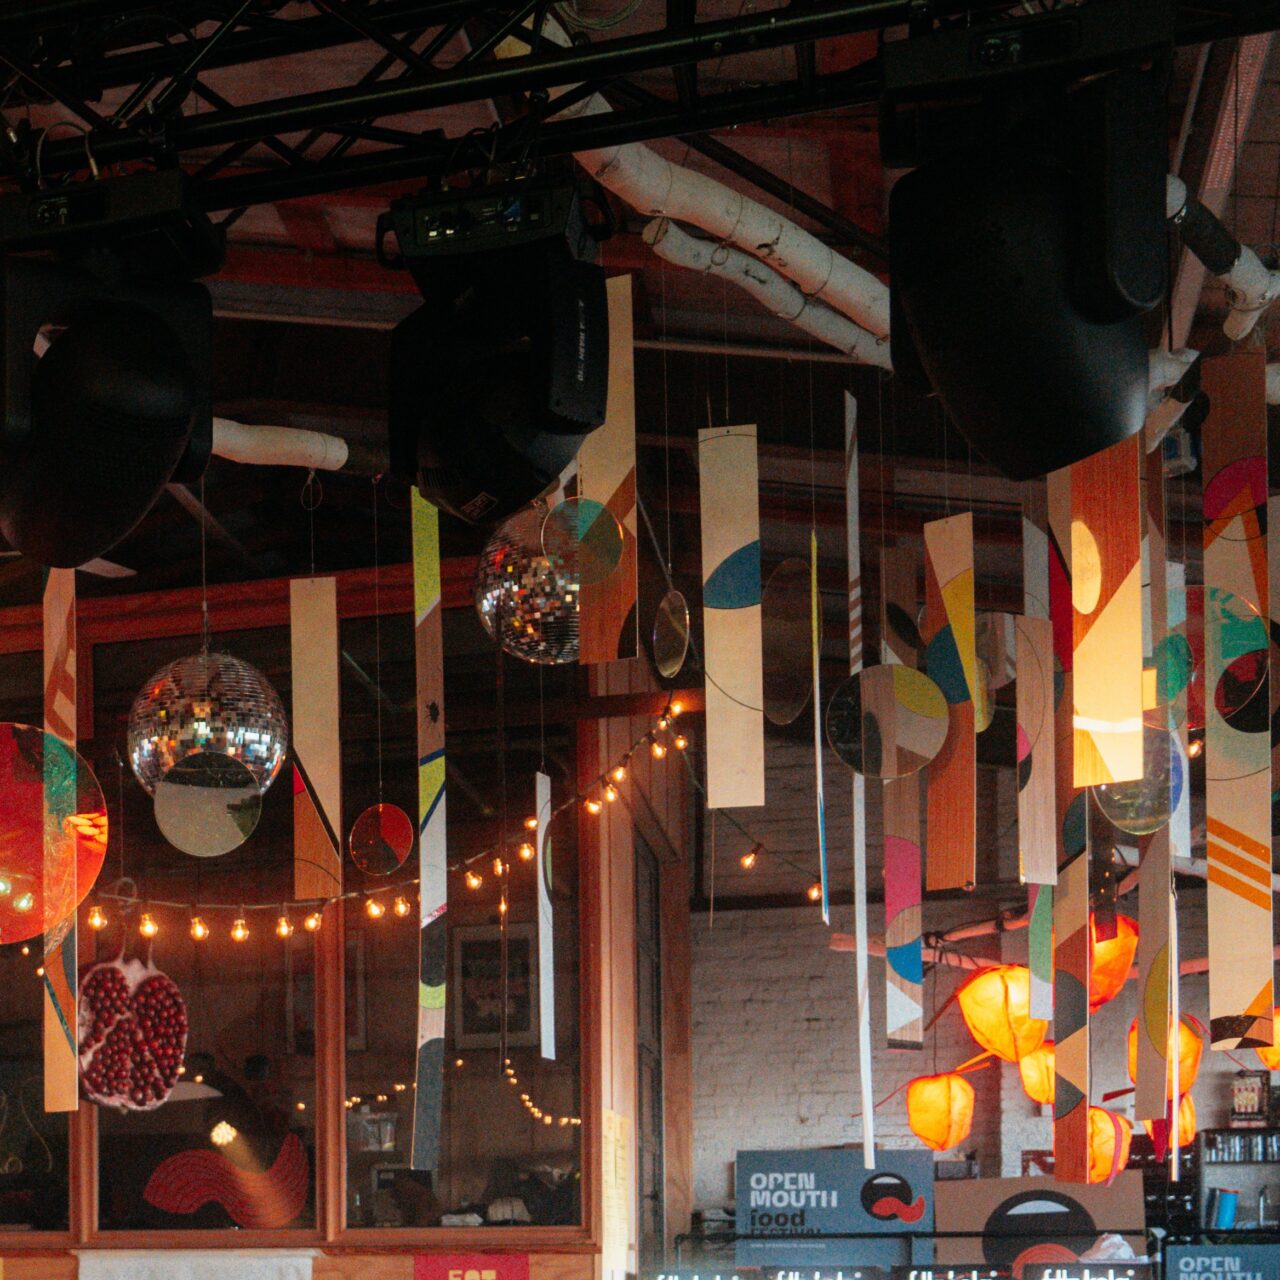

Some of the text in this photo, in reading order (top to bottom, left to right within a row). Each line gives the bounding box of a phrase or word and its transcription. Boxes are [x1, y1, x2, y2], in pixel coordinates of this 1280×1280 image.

[750, 1172, 815, 1190] OPEN
[750, 1190, 838, 1208] MOUTH
[750, 1209, 806, 1226] food
[1179, 1257, 1240, 1272] OPEN
